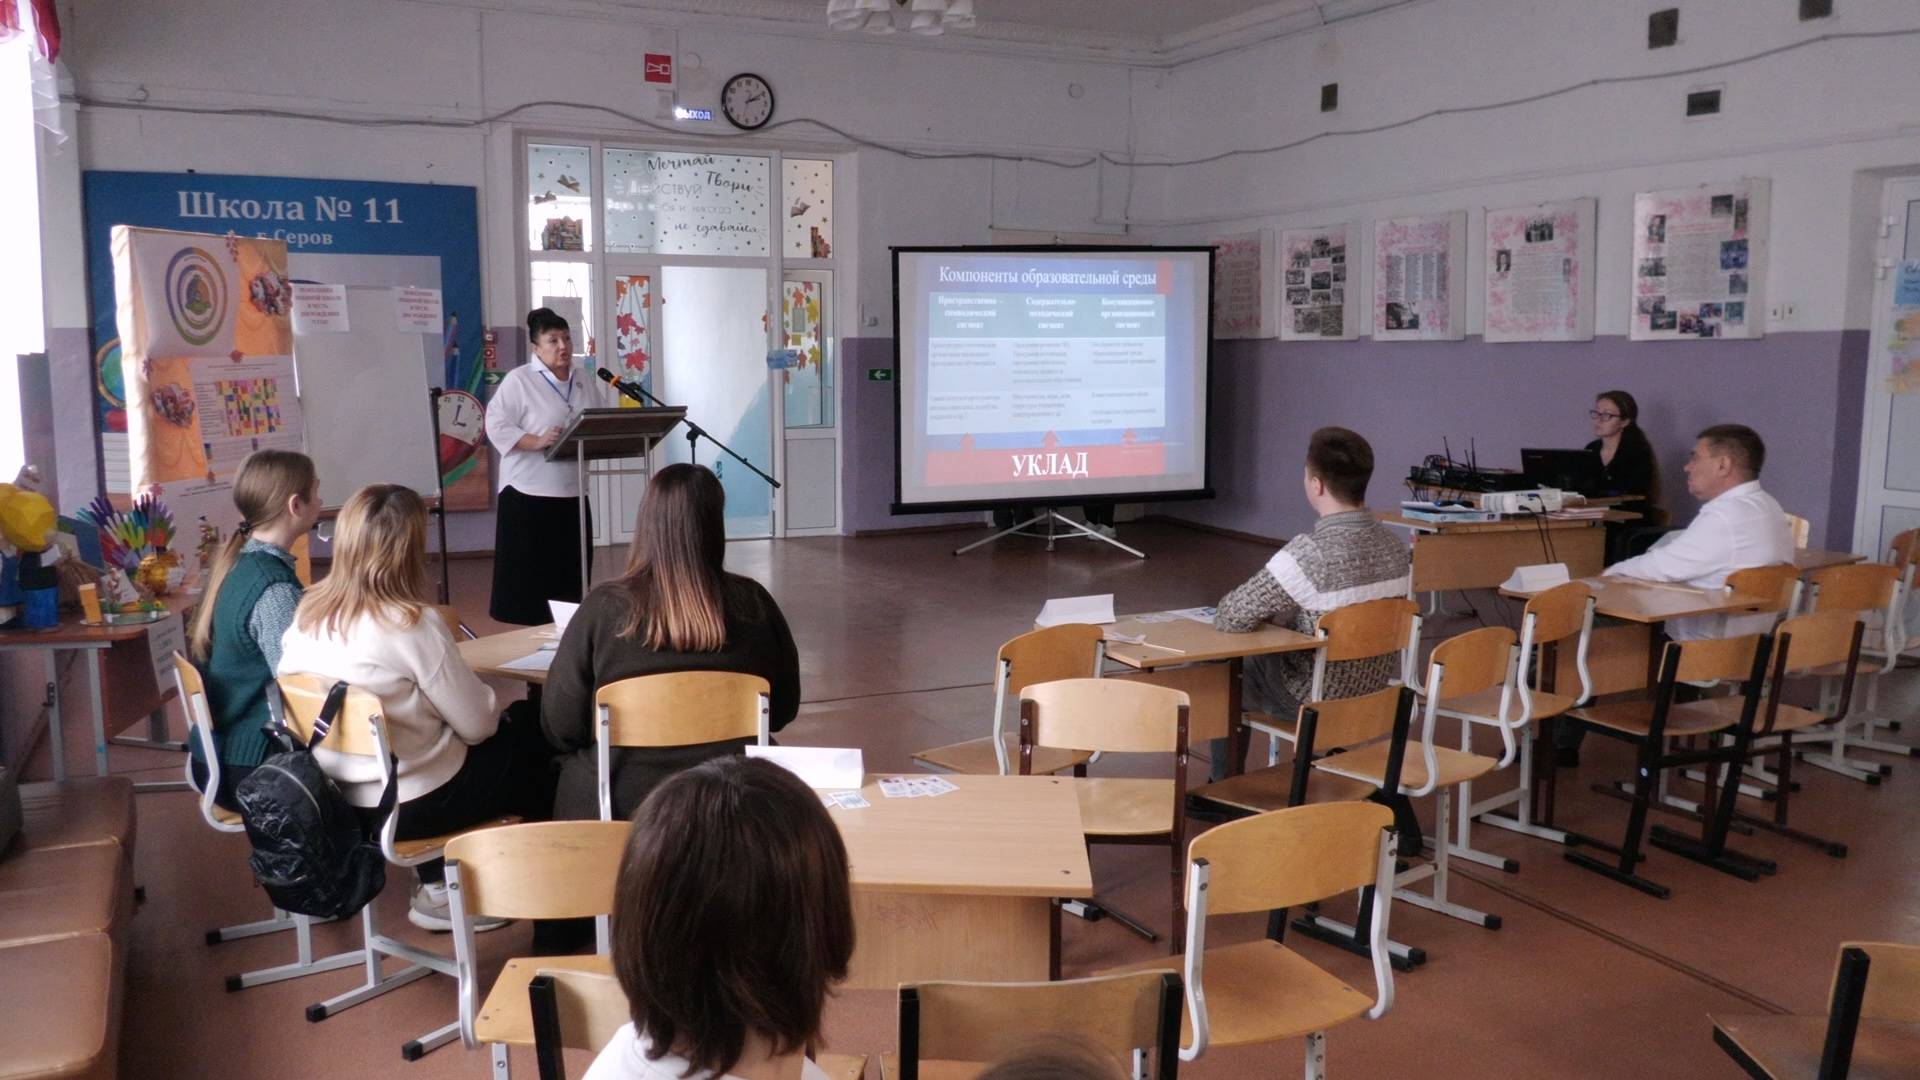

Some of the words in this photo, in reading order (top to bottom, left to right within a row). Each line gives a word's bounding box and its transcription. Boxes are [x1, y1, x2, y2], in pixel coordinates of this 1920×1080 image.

[647, 155, 715, 171] Мечтай
[706, 170, 753, 193] Твори
[177, 191, 305, 221] Школа
[315, 196, 352, 222] №
[364, 198, 404, 224] 11
[274, 229, 334, 248] Серов
[674, 222, 689, 231] не
[696, 220, 760, 237] сдавайся
[939, 266, 1018, 283] Компоненты
[1021, 268, 1119, 288] образовательной
[1122, 272, 1157, 288] среды
[1011, 452, 1089, 479] УКЛАД
